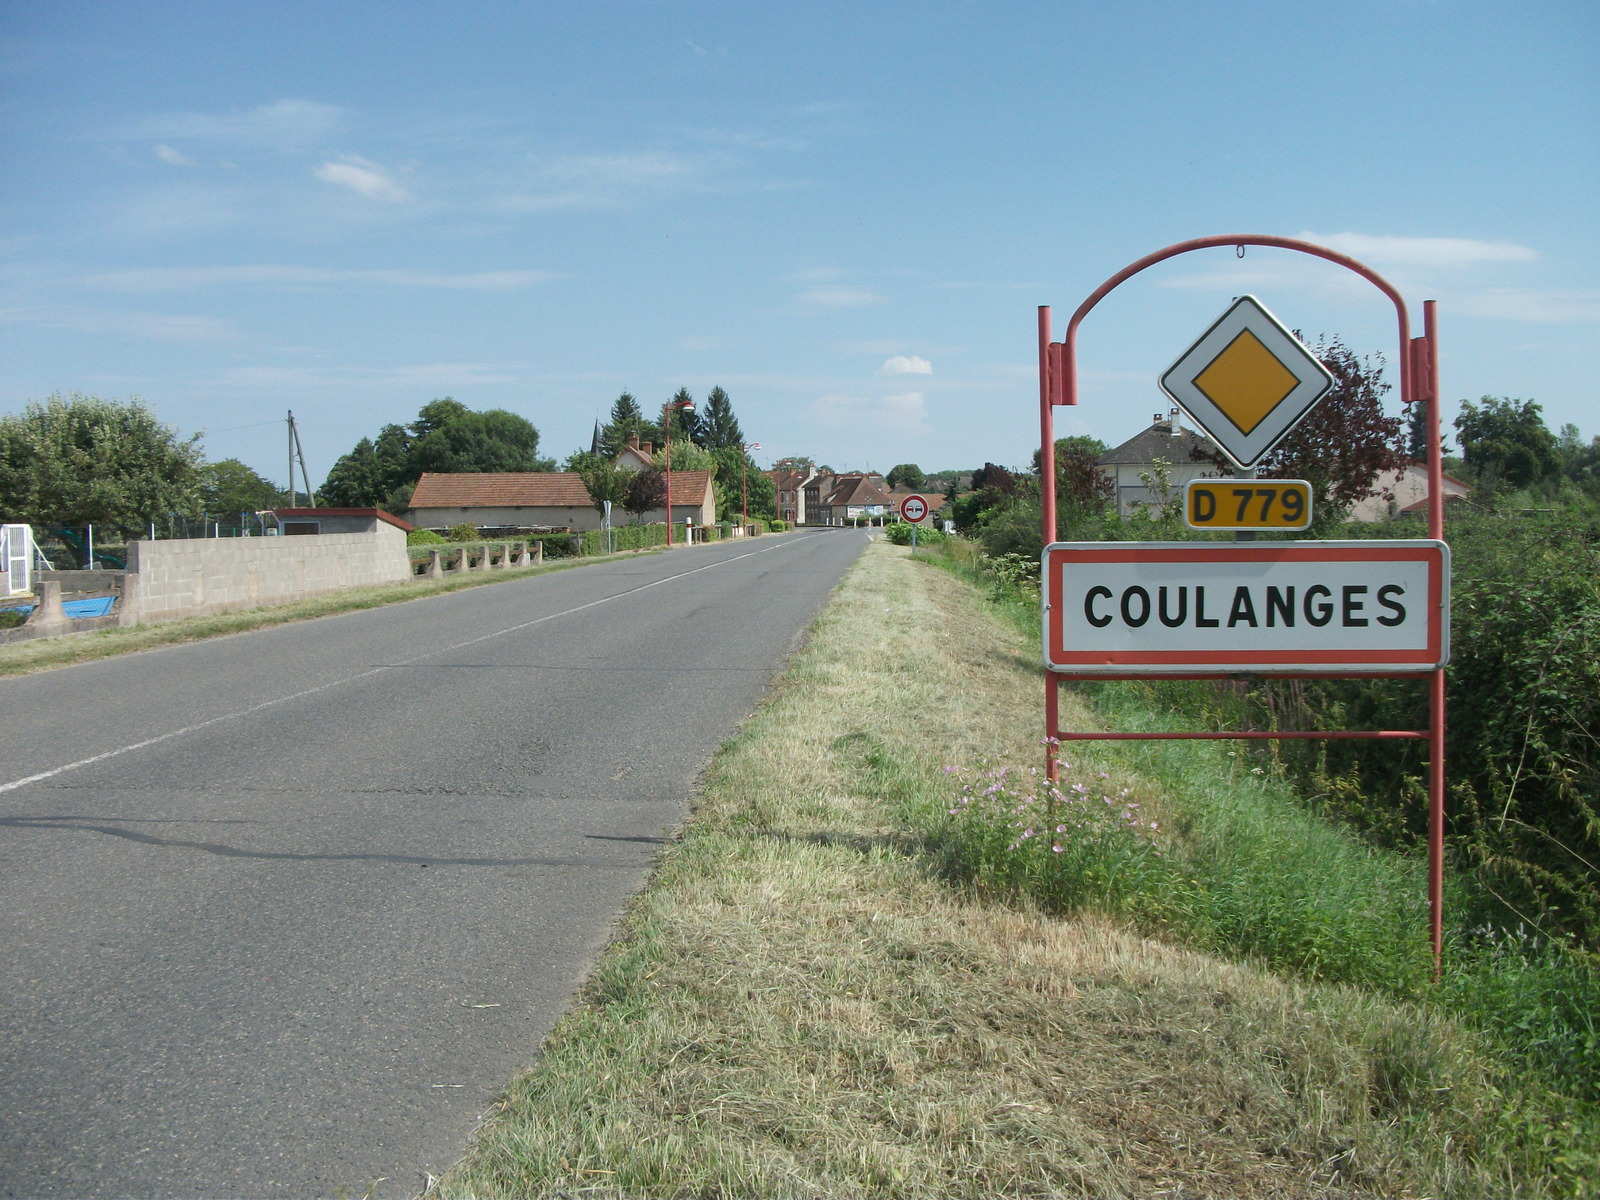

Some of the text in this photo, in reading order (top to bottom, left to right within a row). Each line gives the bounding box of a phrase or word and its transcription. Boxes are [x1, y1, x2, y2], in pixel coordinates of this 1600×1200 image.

[1194, 489, 1304, 522] D 779
[1084, 584, 1407, 628] COULANGES
